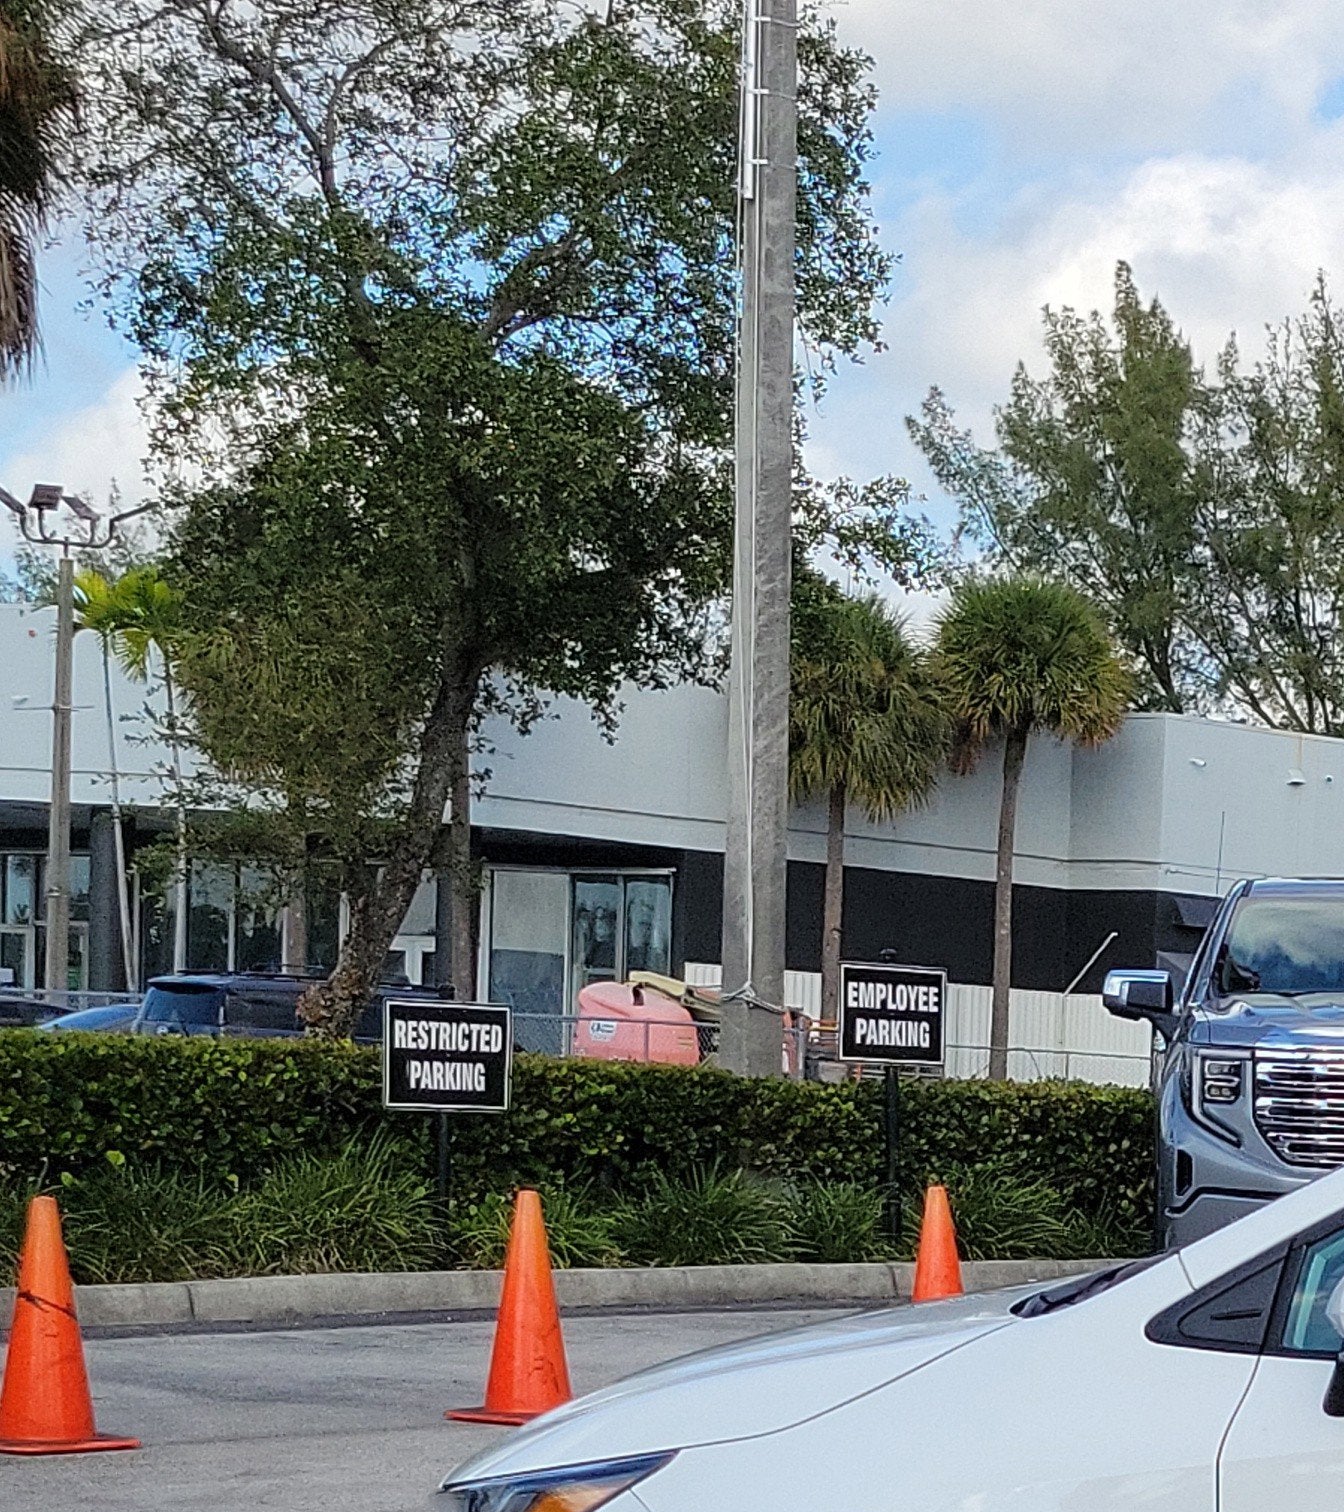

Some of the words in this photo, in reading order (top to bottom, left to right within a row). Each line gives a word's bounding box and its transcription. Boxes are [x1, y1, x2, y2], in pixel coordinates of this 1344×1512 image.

[847, 981, 939, 1013] EMPLOYEE
[394, 1018, 503, 1053] RESTRICTED
[855, 1017, 930, 1048] PARKING
[409, 1060, 486, 1092] PARKING
